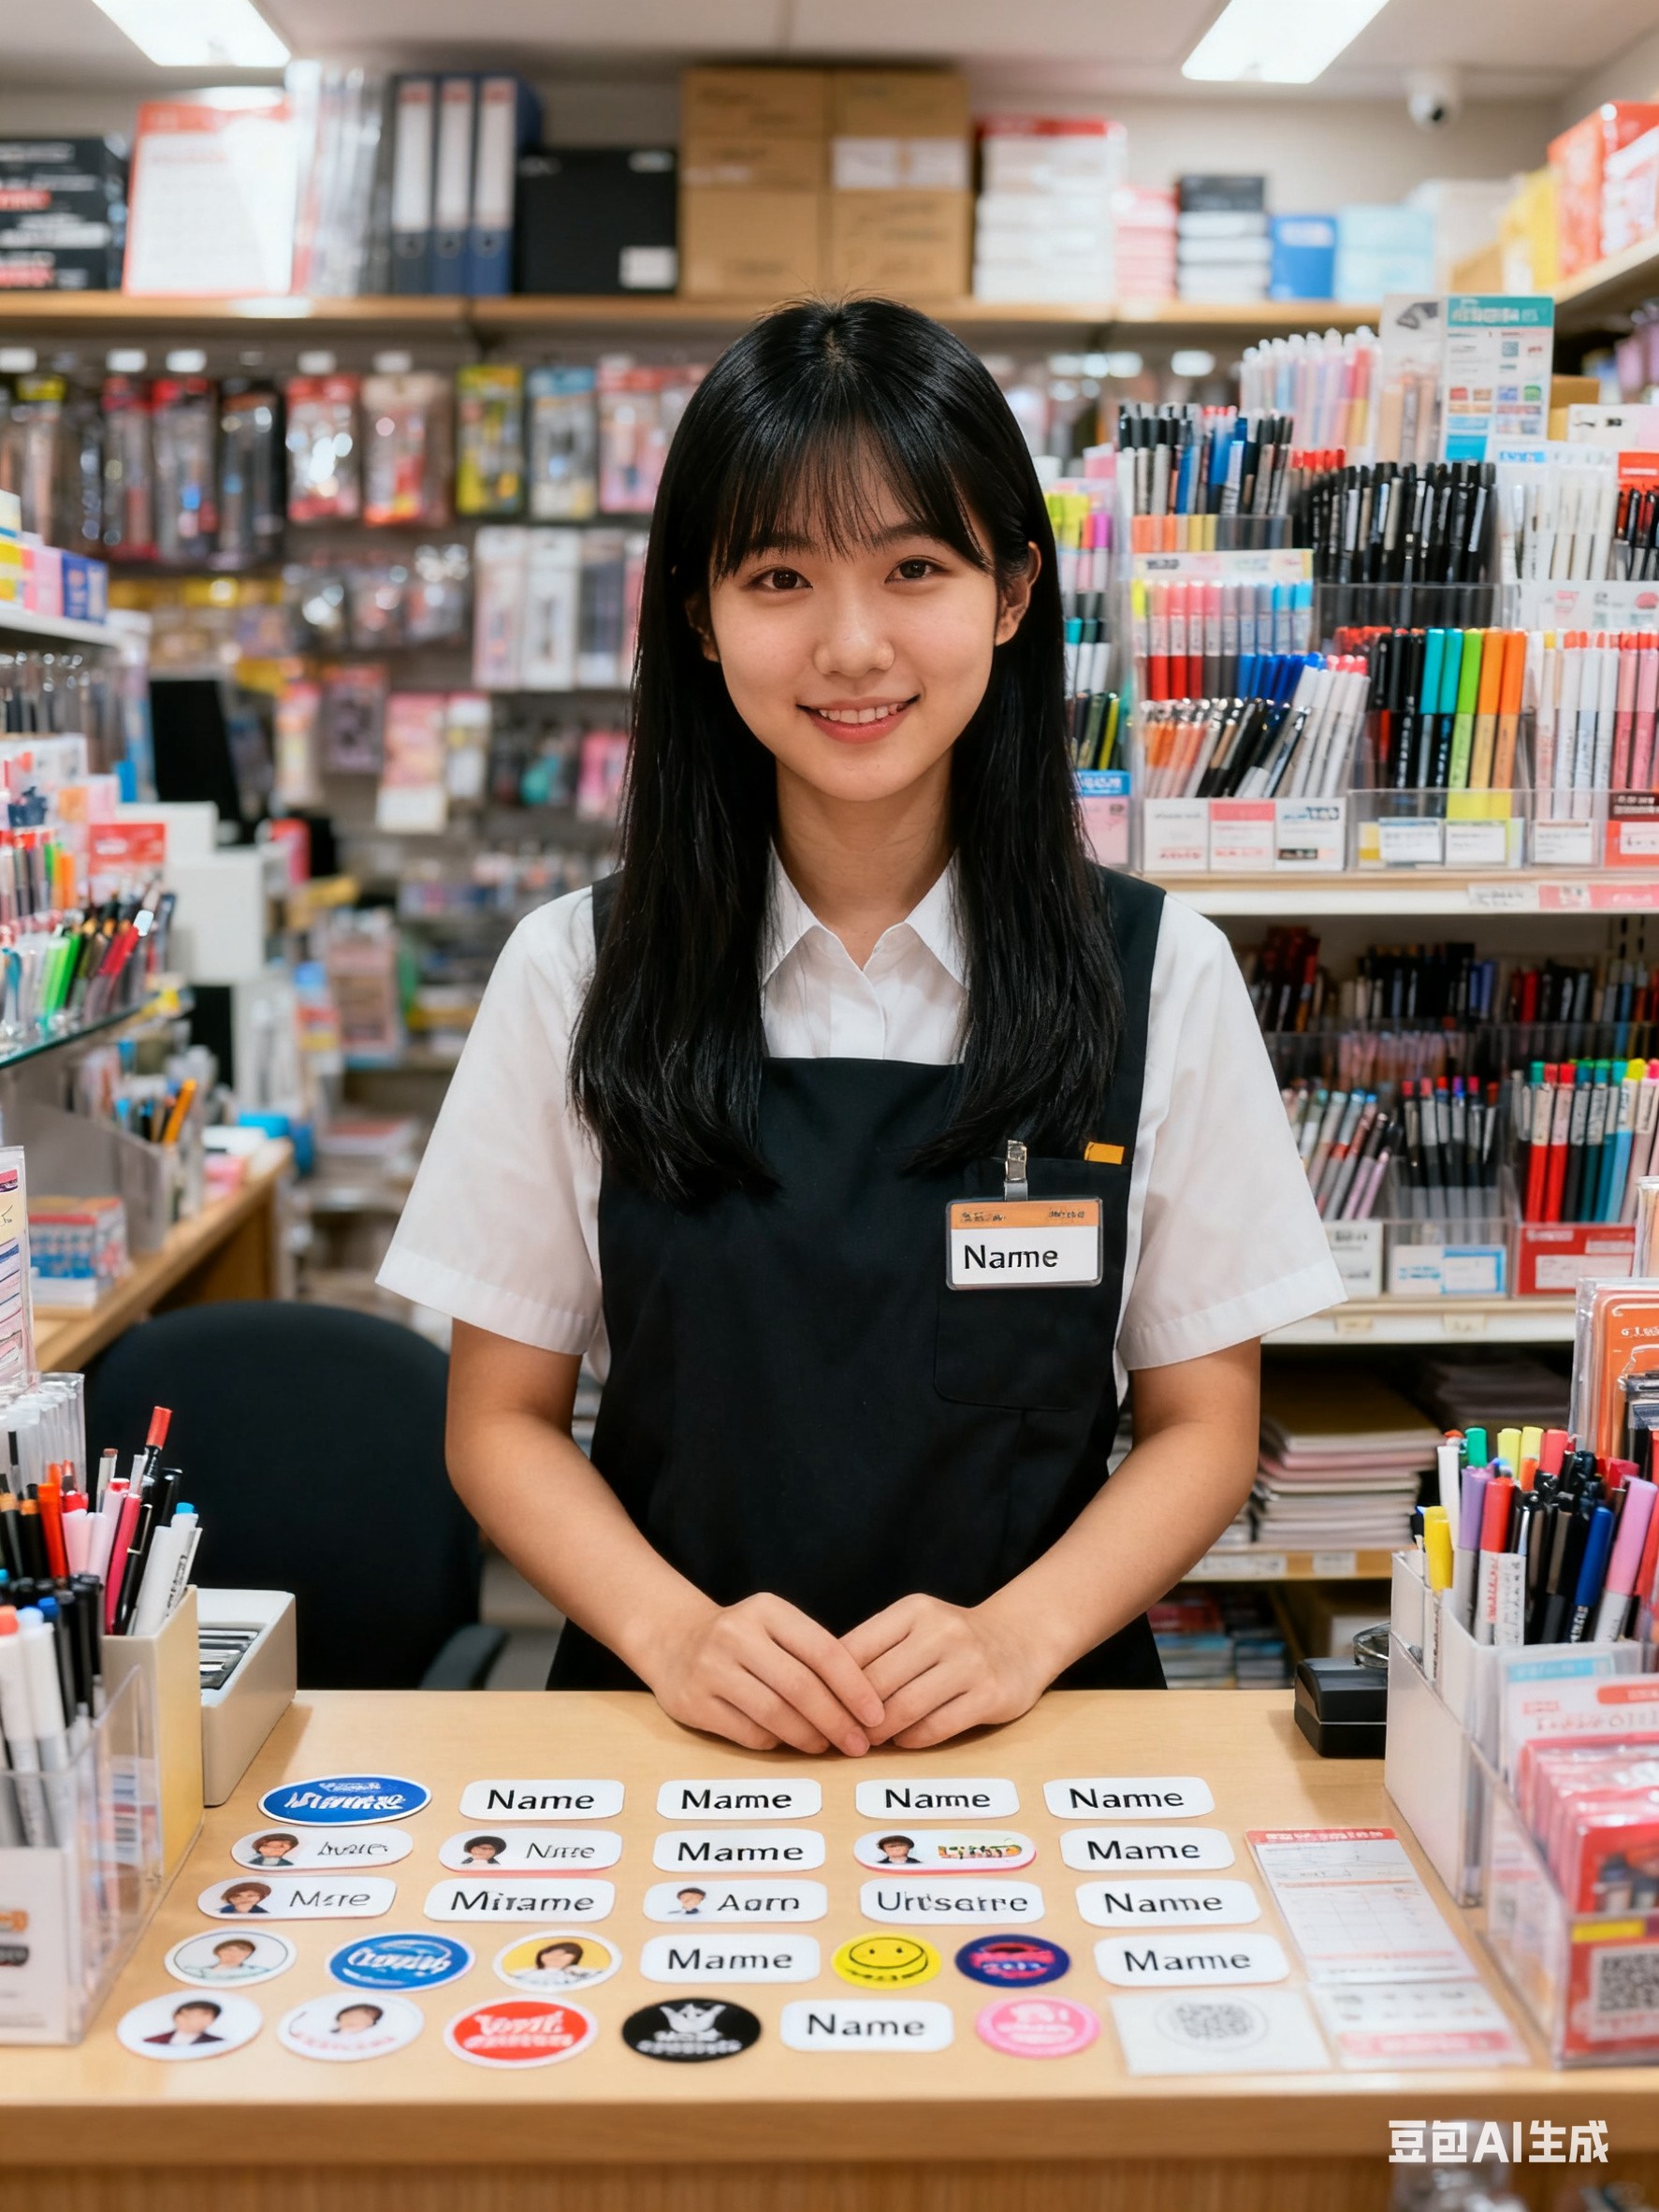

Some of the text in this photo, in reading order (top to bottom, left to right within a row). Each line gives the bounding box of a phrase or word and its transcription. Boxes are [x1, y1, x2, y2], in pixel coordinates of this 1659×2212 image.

[964, 1244, 1059, 1270] Name
[487, 1788, 595, 1811] Name
[884, 1787, 991, 1810] Name
[1069, 1787, 1185, 1810] Name
[1086, 1840, 1201, 1861] Mame
[807, 2013, 925, 2036] Name
